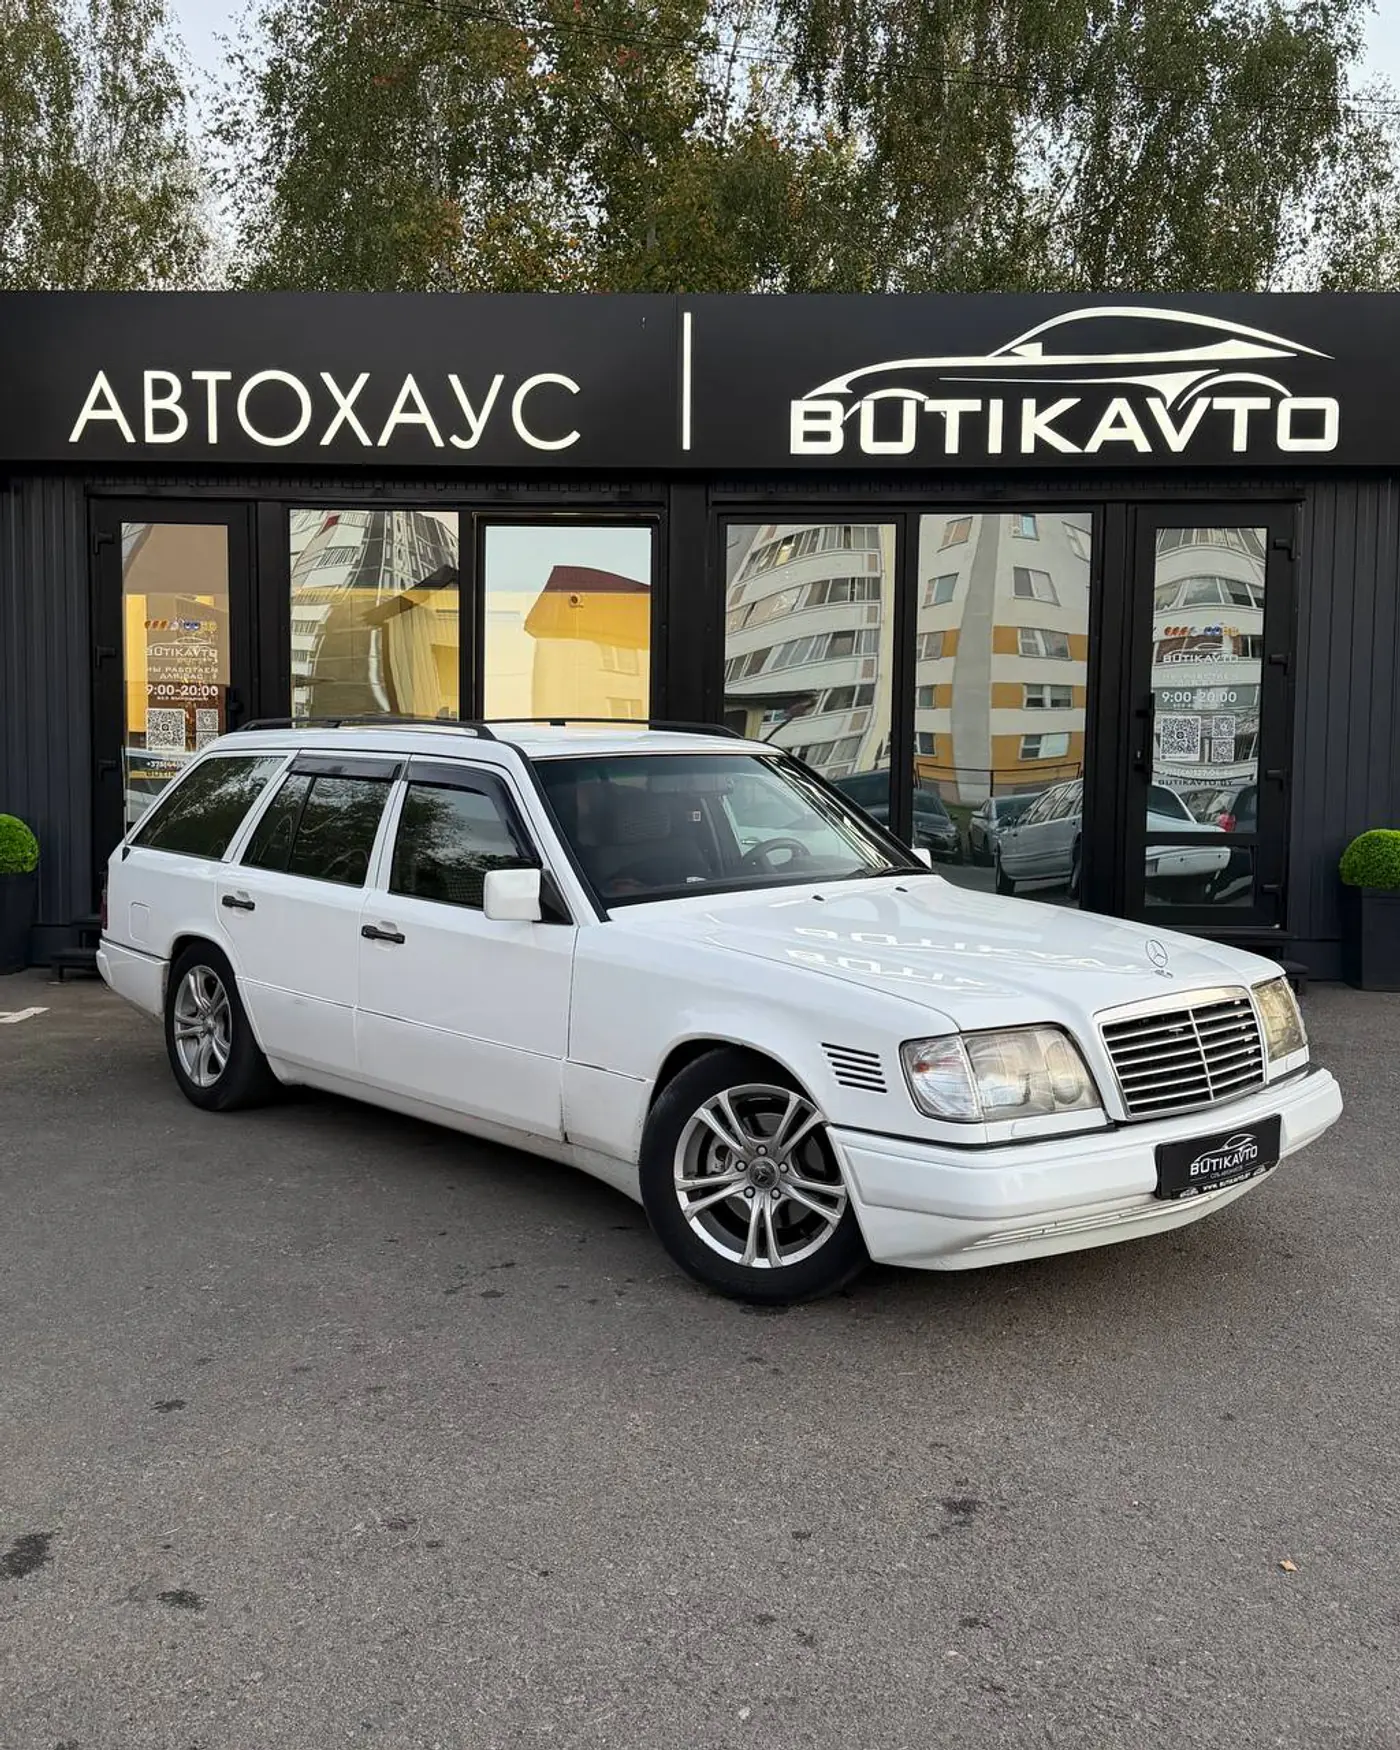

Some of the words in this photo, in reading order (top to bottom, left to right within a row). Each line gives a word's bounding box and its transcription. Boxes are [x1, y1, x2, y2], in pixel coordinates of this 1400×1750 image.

[68, 370, 581, 450] АВТОХАУС
[790, 396, 1340, 454] BUTIKAVTO
[1163, 653, 1239, 663] BUTIKAVTO
[146, 684, 219, 696] 9:00-20:00
[1190, 1145, 1258, 1176] BUTIKAVTO
